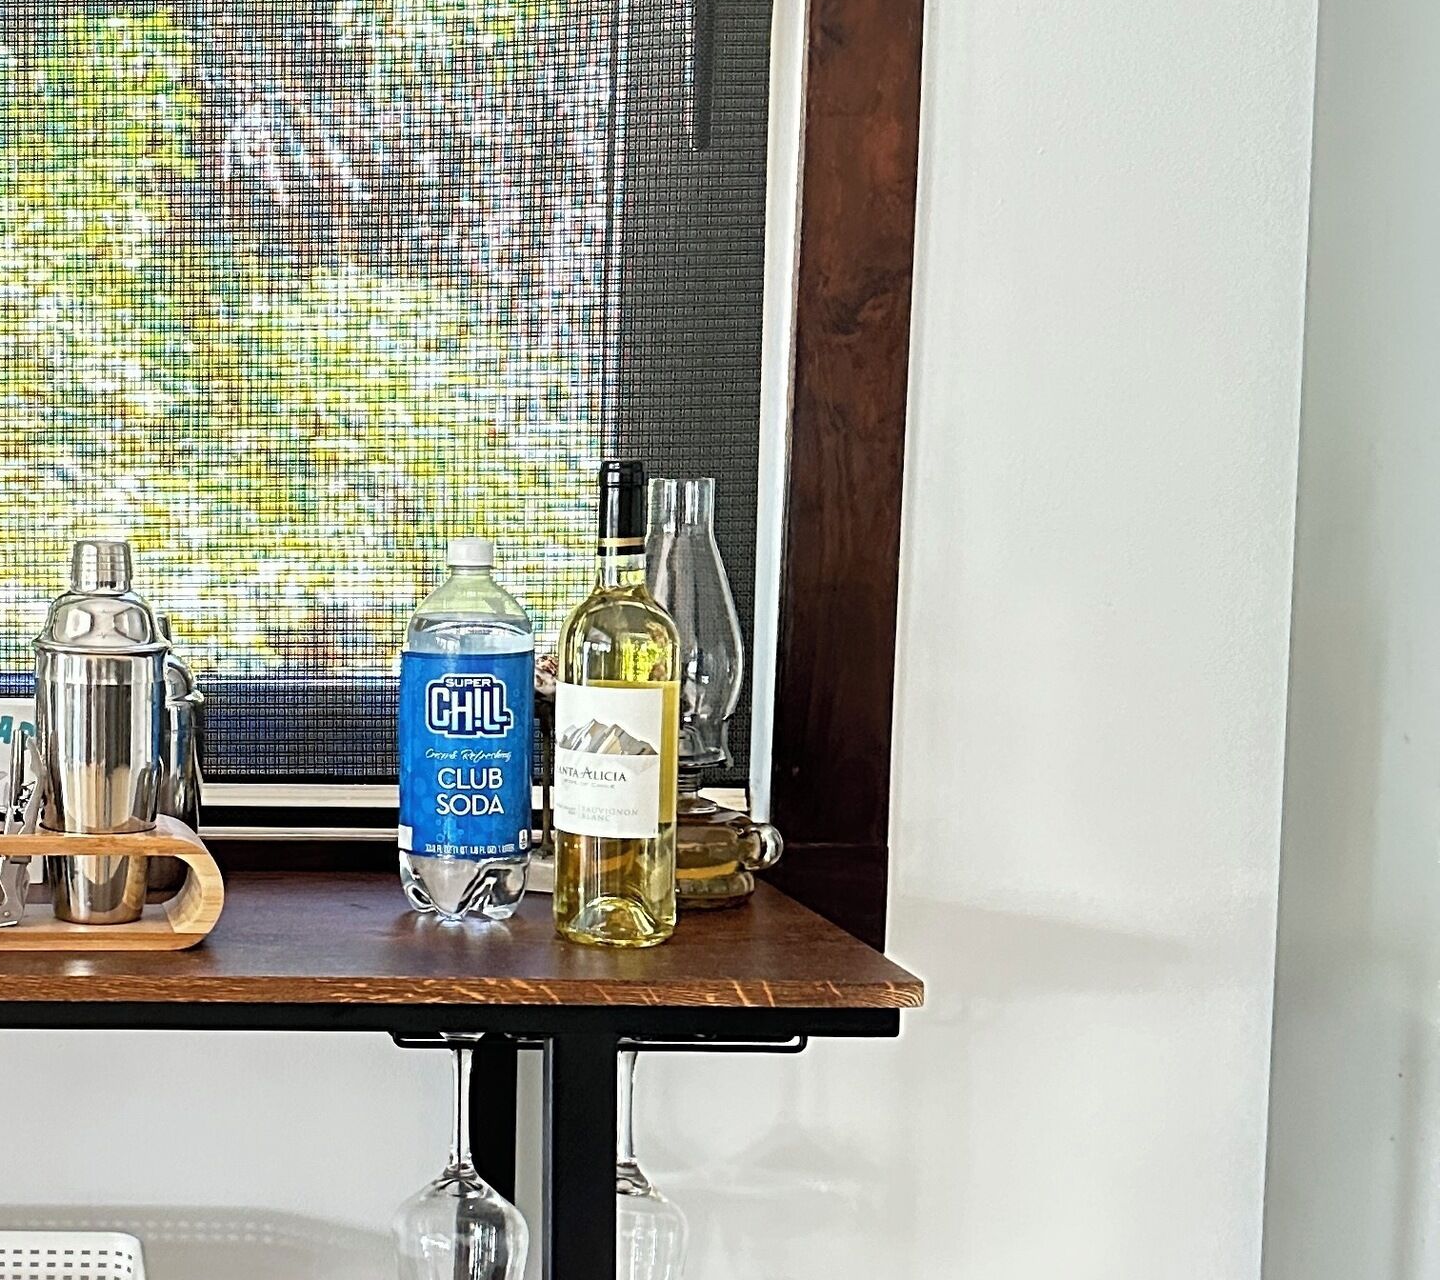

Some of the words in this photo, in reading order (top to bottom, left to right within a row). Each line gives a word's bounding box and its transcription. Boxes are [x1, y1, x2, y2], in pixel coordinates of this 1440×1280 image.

[445, 678, 491, 688] SUPER
[437, 767, 503, 790] CLUB
[557, 764, 579, 778] ANTA
[581, 766, 626, 782] ALICIA
[436, 793, 505, 816] SODA
[582, 805, 639, 816] SAUVIGNON
